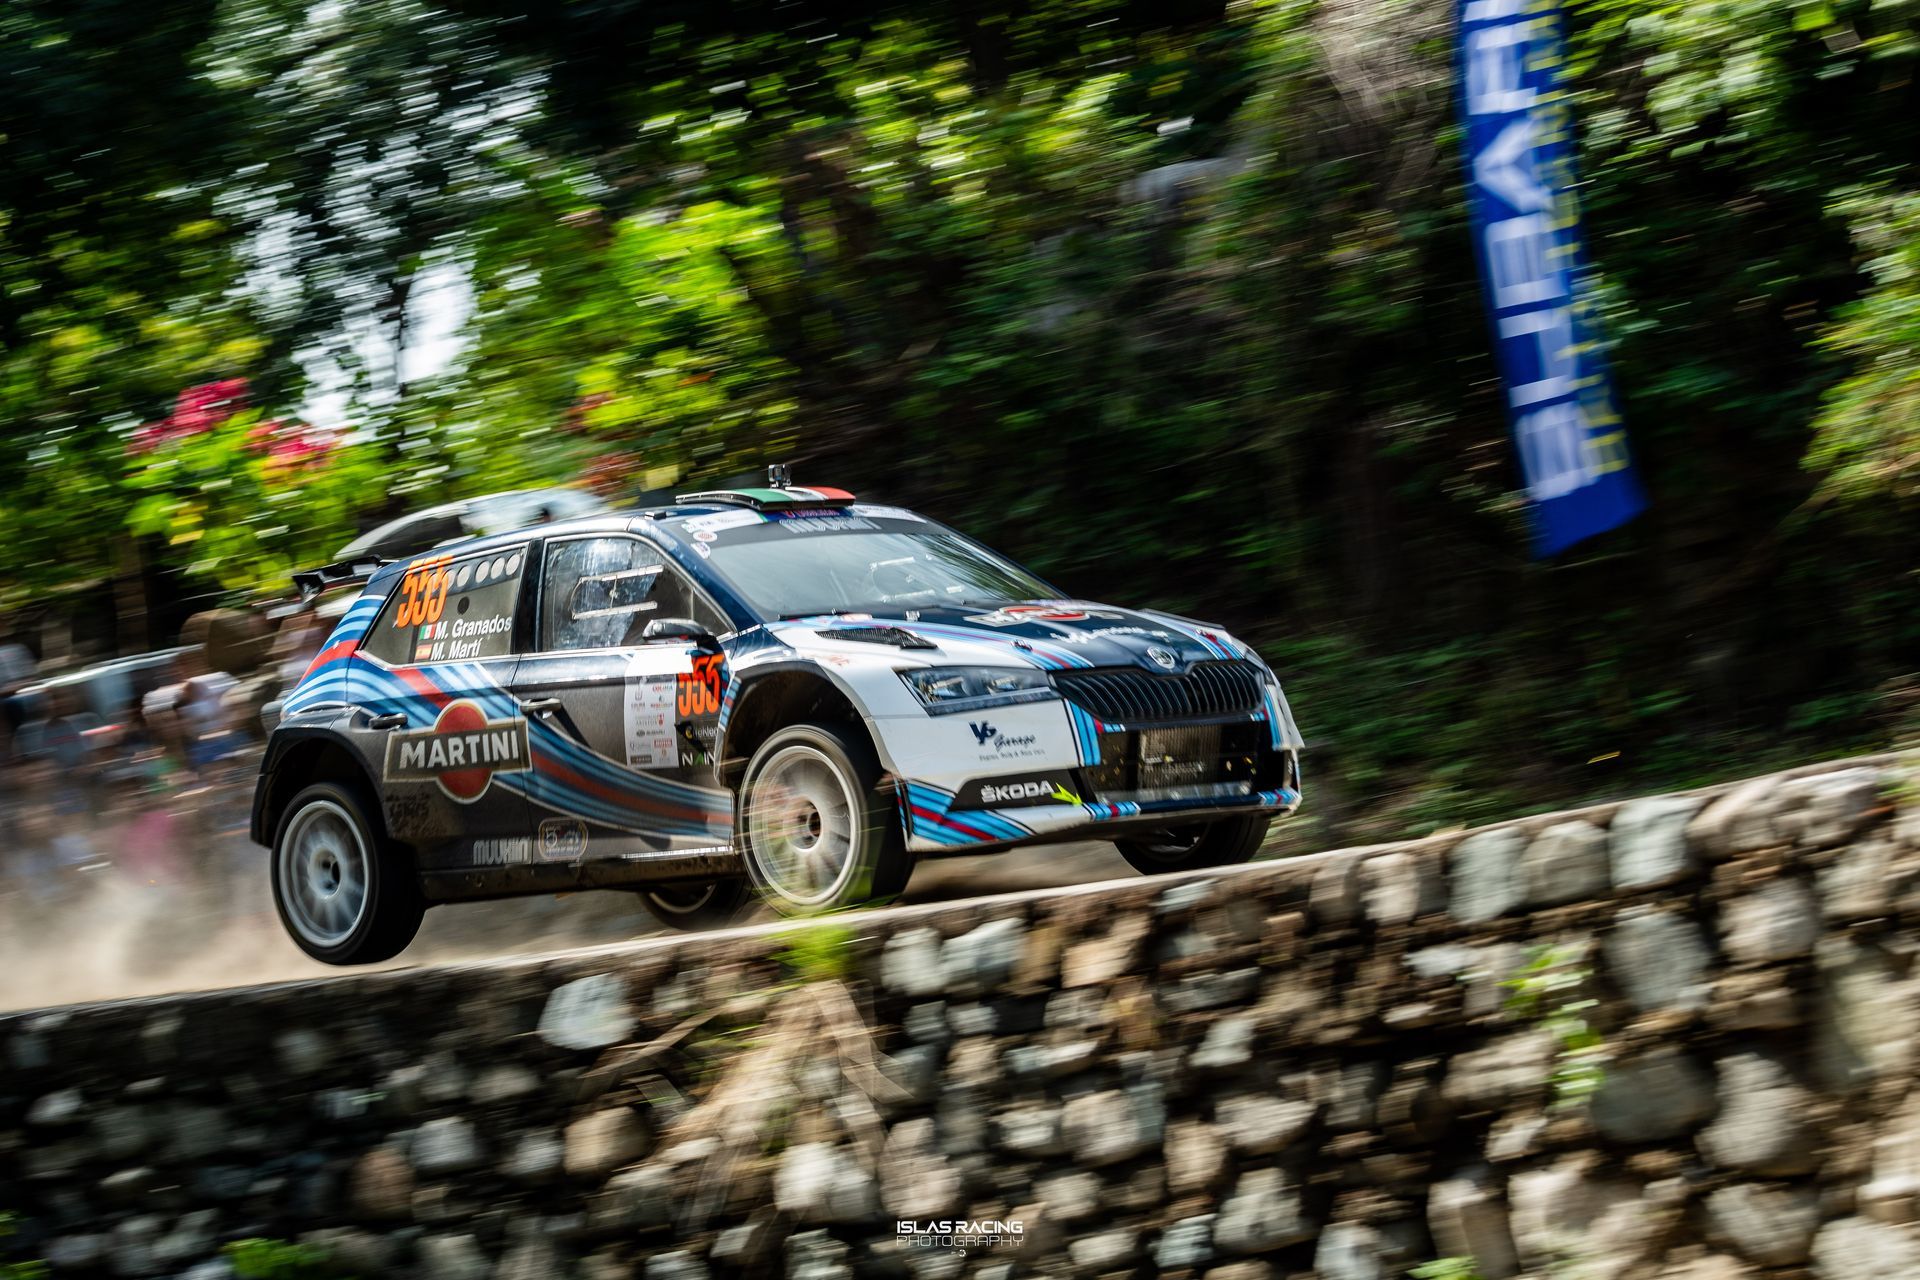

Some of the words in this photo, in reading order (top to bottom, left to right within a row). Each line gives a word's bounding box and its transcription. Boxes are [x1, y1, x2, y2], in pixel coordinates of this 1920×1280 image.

[396, 554, 455, 628] 555
[434, 621, 448, 640] M.
[452, 614, 512, 639] Granados
[431, 642, 445, 661] M.
[448, 637, 483, 659] Martí
[678, 654, 724, 717] 555
[400, 730, 519, 769] MARTINI
[981, 780, 1055, 803] ŠKODA
